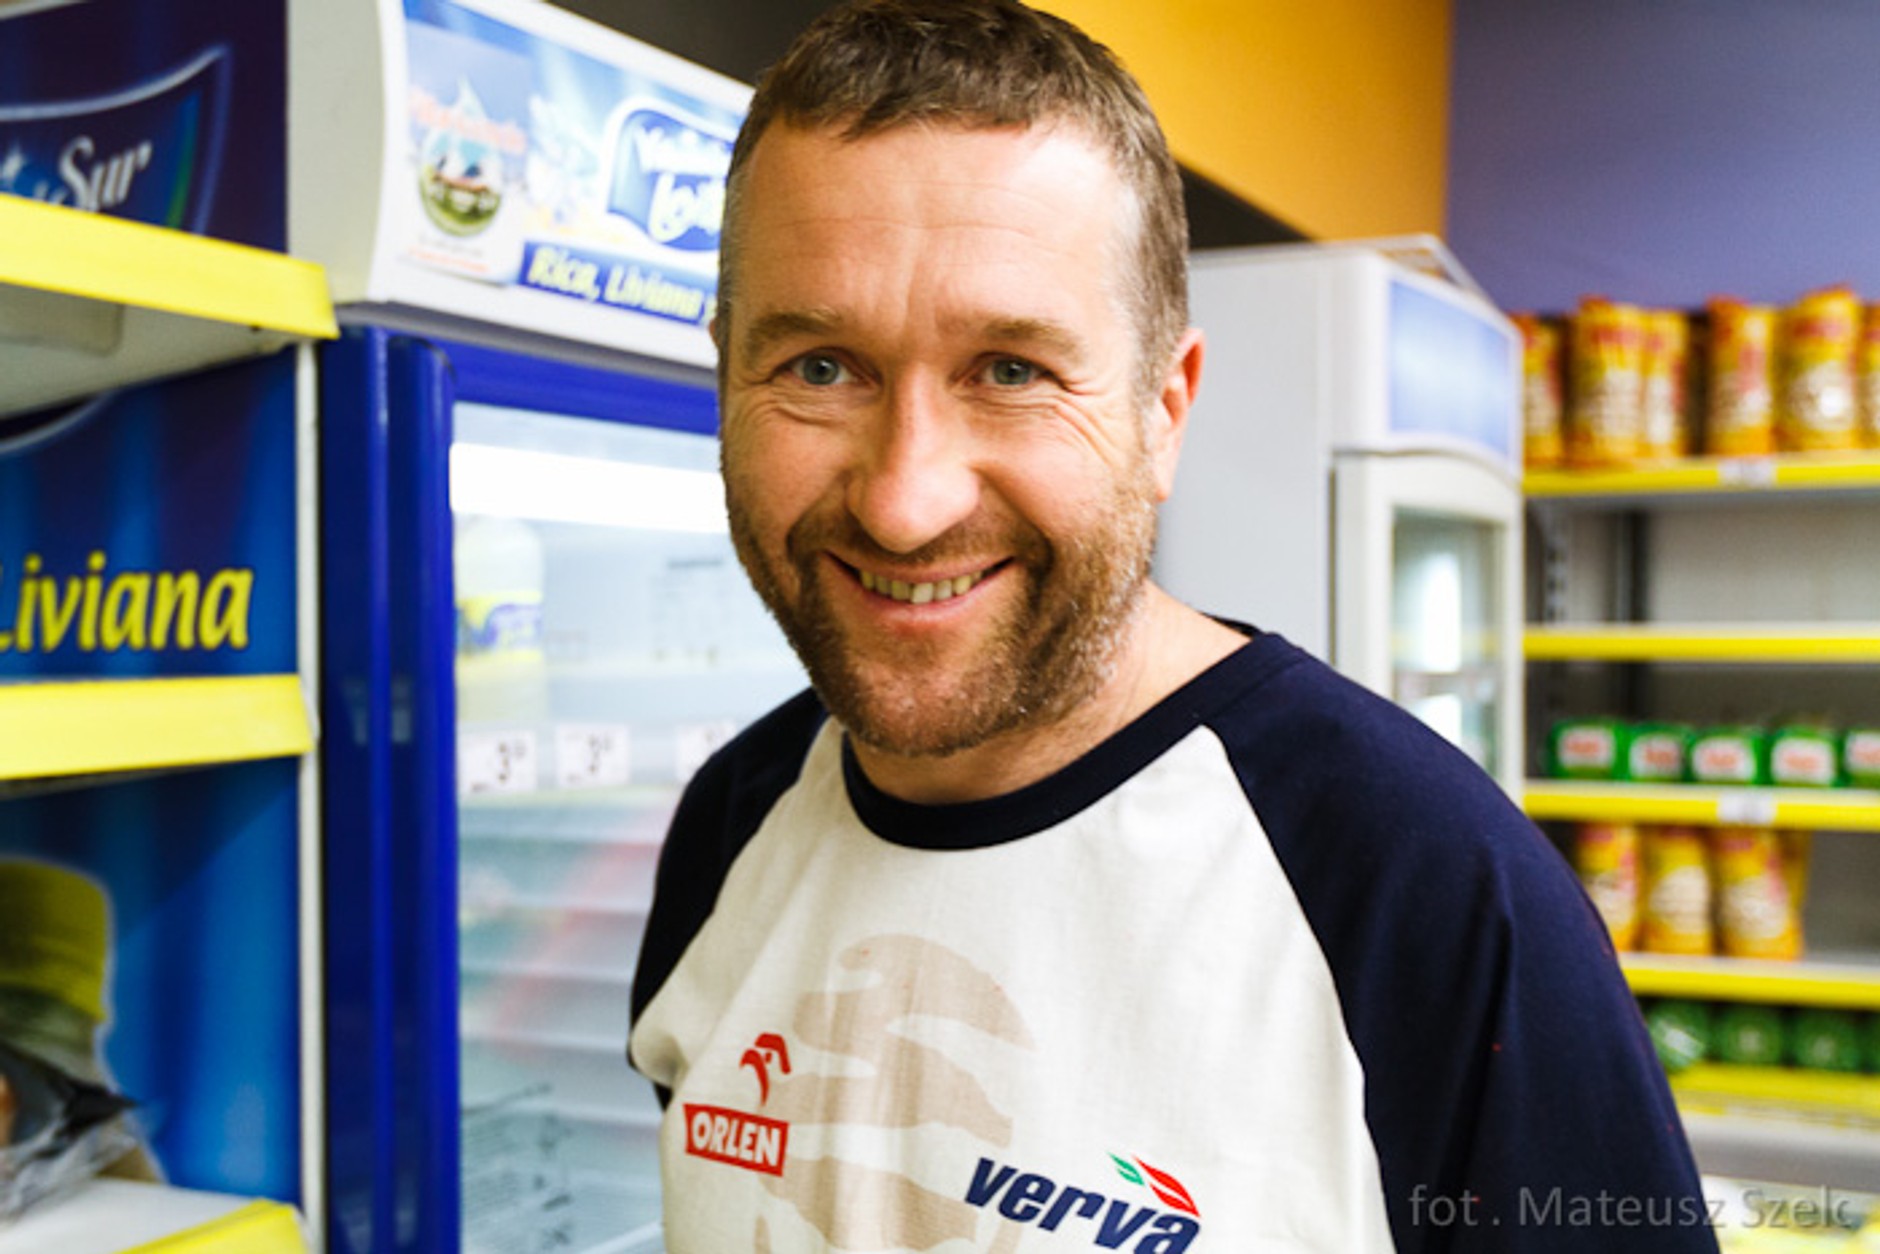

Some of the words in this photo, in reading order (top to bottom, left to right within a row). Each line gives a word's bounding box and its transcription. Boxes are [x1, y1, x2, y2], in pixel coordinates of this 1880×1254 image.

[527, 246, 602, 303] Rica,
[692, 1111, 780, 1167] ORLEN
[964, 1157, 1201, 1254] verva
